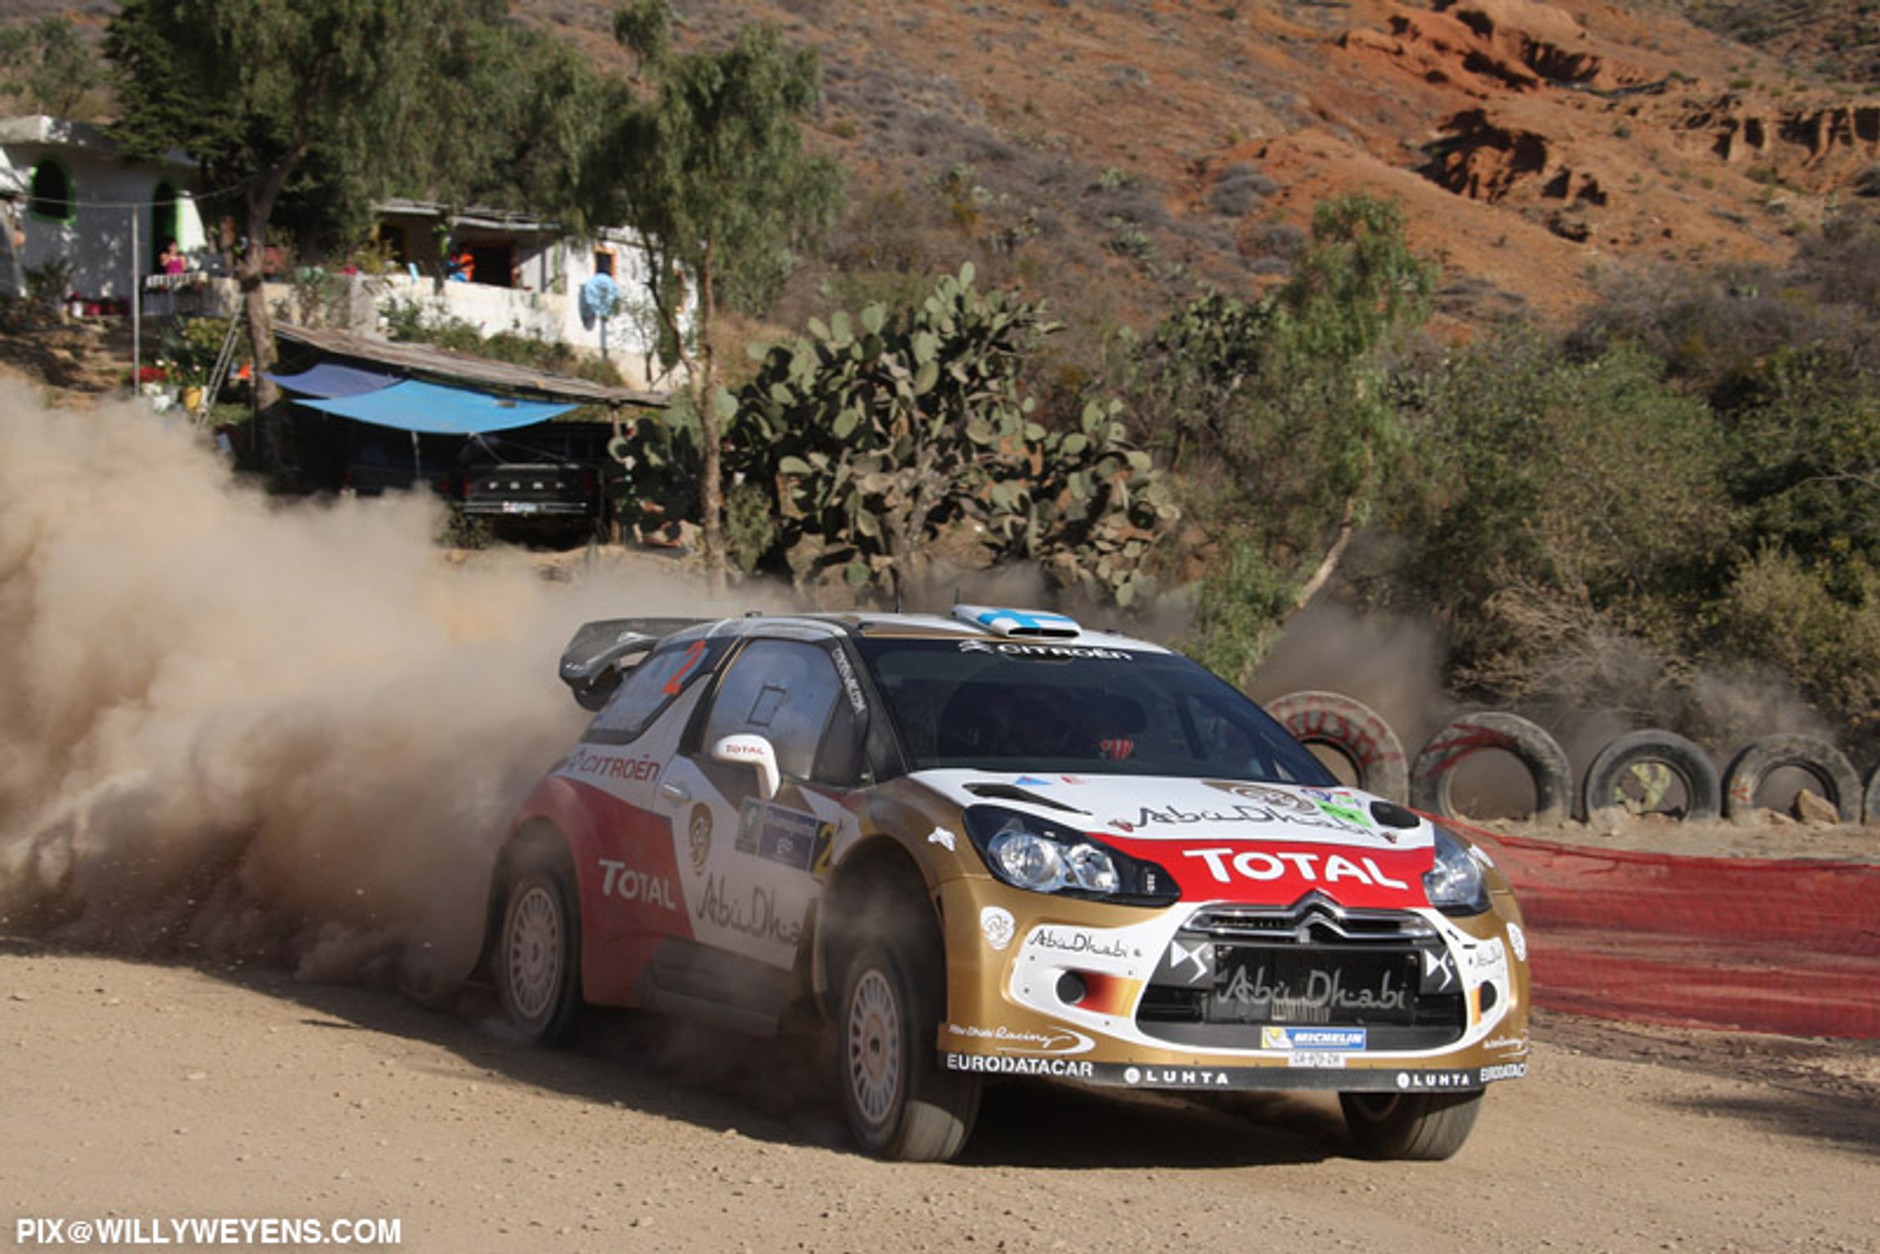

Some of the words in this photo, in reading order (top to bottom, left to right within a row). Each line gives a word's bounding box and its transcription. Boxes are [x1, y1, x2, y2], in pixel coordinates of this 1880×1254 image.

[661, 639, 706, 694] 2
[725, 744, 764, 755] TOTAL
[813, 822, 837, 877] 2
[1182, 847, 1409, 890] TOTAL
[598, 859, 677, 911] TOTAL
[1294, 1030, 1364, 1046] MICHELIN
[947, 1054, 1094, 1077] EURODATACAR
[1146, 1069, 1229, 1085] LUHTA
[1412, 1073, 1471, 1087] LUHTA
